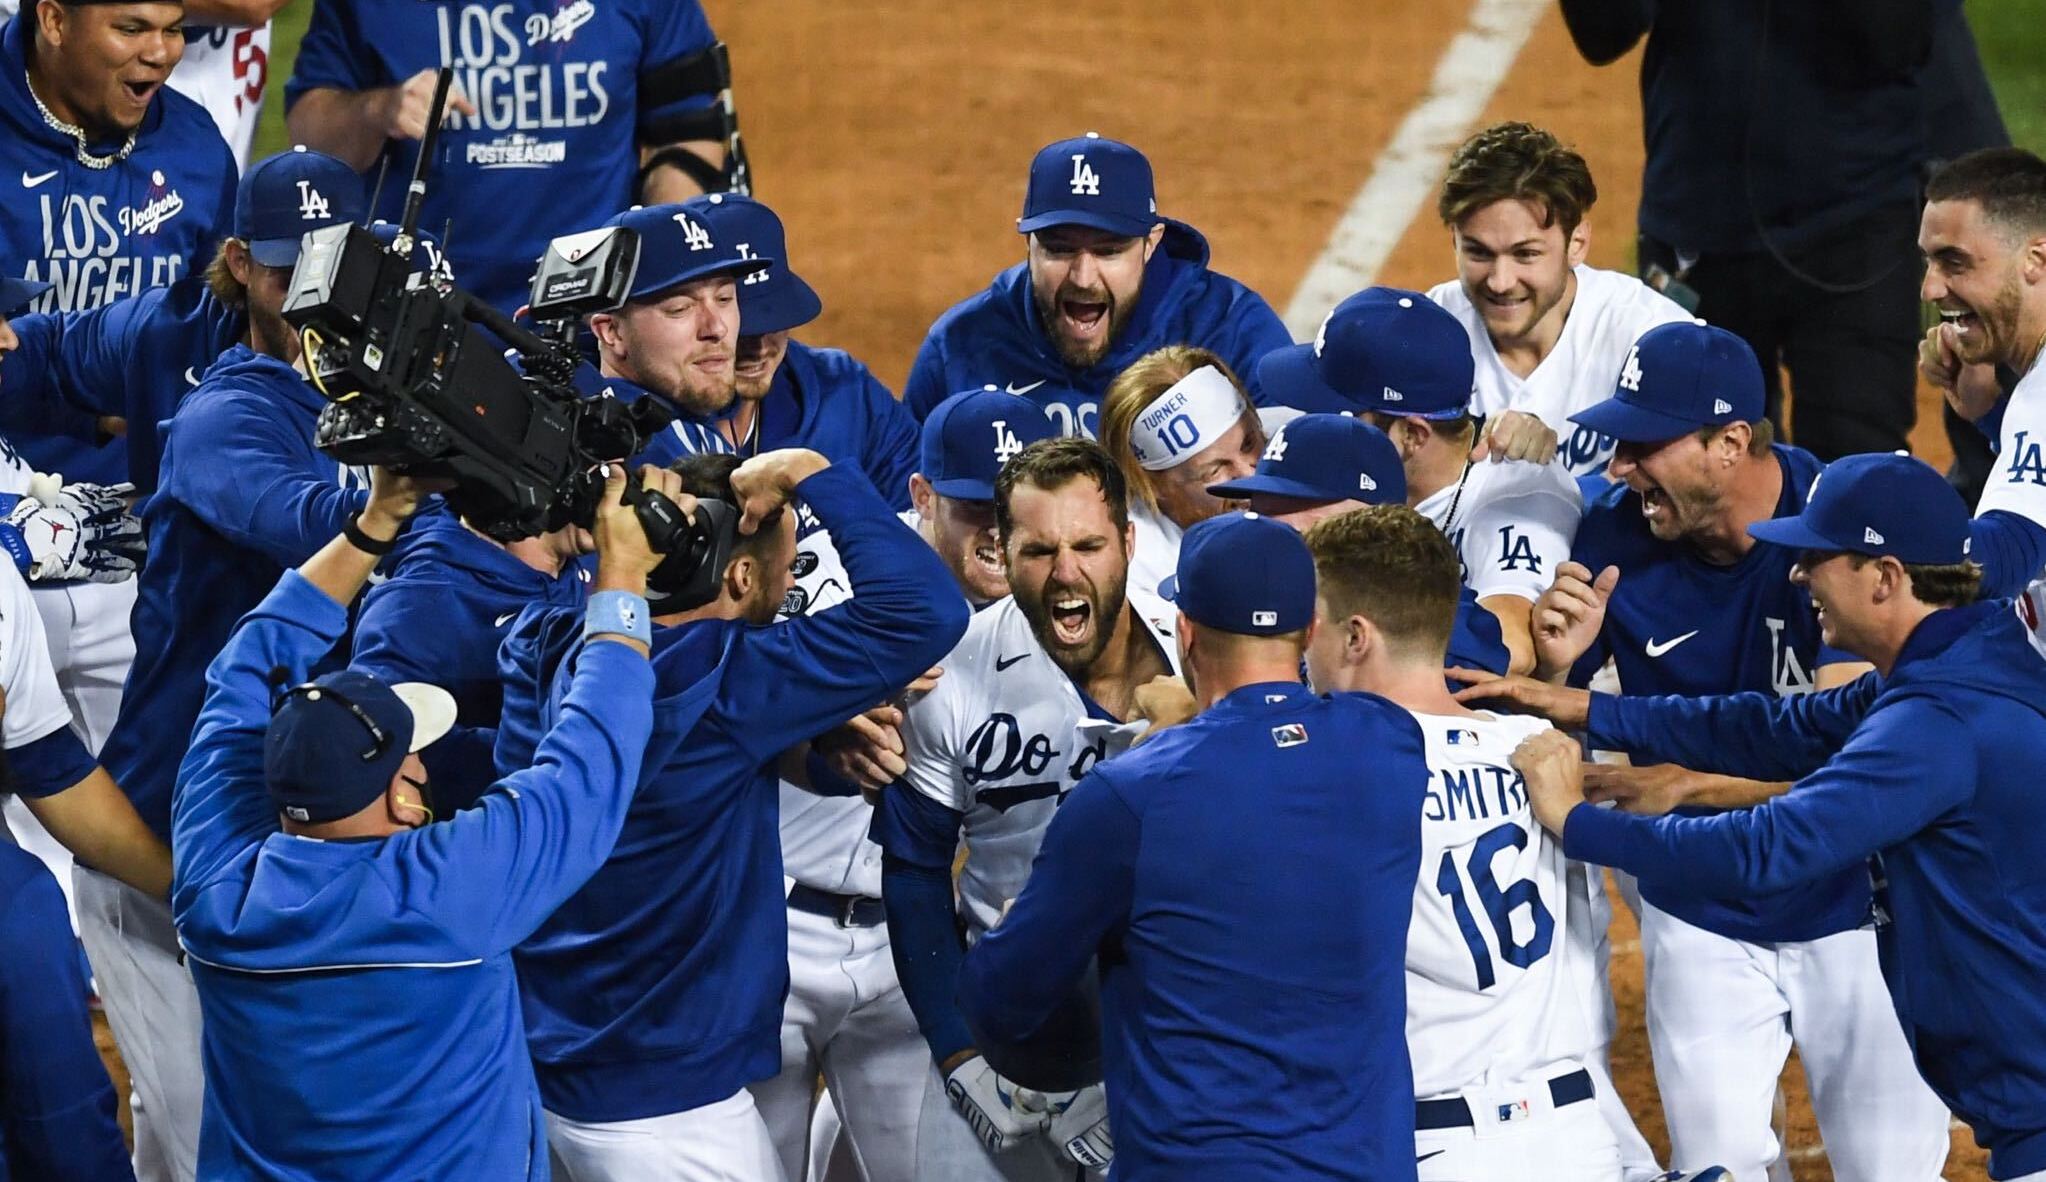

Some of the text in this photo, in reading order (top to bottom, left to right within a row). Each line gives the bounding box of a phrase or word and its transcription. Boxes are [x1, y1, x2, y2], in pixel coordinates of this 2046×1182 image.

[437, 4, 521, 70] LOS
[443, 61, 609, 130] NGELES
[466, 140, 566, 164] POSTSEASON
[1070, 154, 1100, 195] LA
[296, 180, 332, 219] LA
[40, 189, 184, 259] LOS Dodgers
[672, 213, 714, 251] LA
[1141, 392, 1188, 431] TURNER
[992, 420, 1023, 462] LA
[1157, 414, 1200, 457] 10
[2007, 429, 2046, 487] LA
[1498, 524, 1542, 575] LA
[1436, 822, 1555, 991] 16
